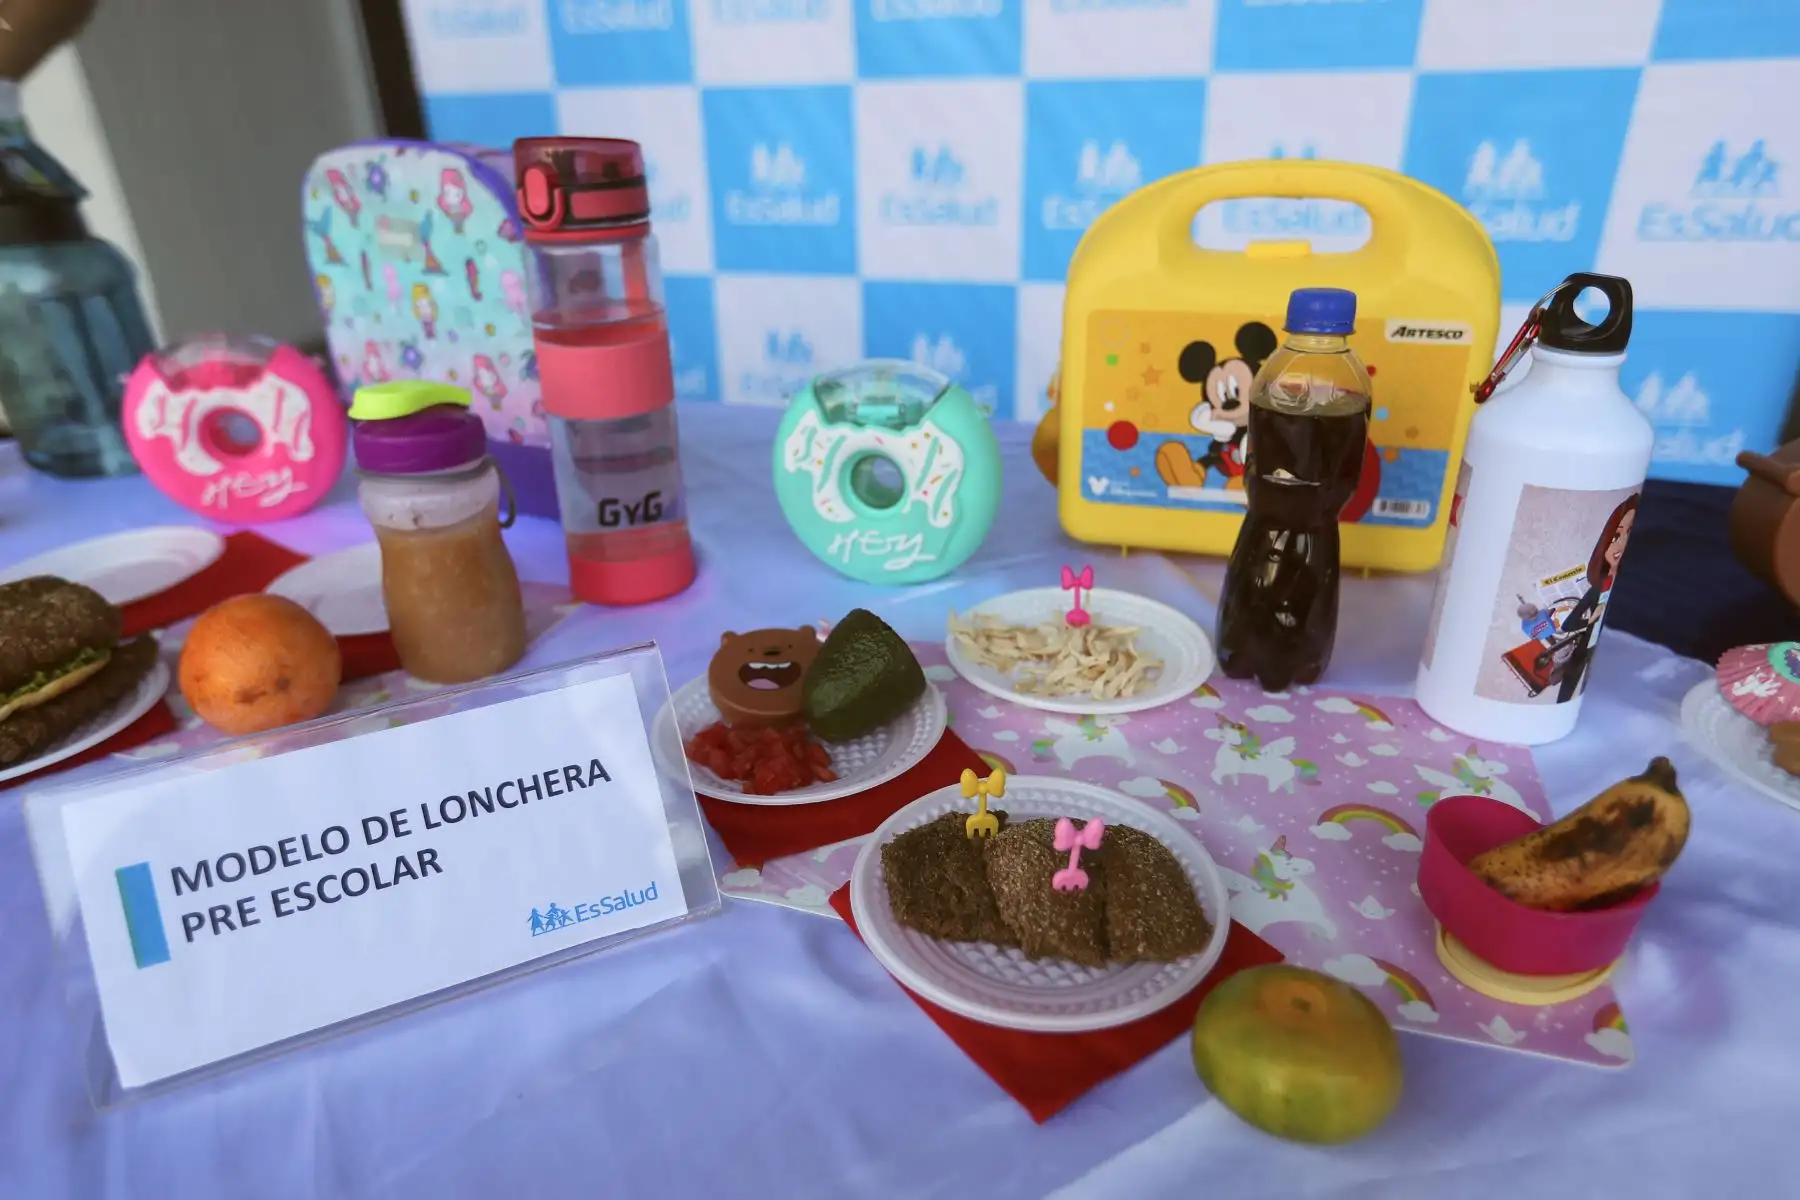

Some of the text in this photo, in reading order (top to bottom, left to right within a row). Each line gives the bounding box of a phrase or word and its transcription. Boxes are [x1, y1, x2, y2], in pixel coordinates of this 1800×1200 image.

[1391, 326, 1463, 340] ARTESCO
[170, 758, 613, 897] MODELO DE LONCHERA
[181, 847, 444, 943] PRE ESCOLAR
[574, 880, 659, 923] EsSalud
